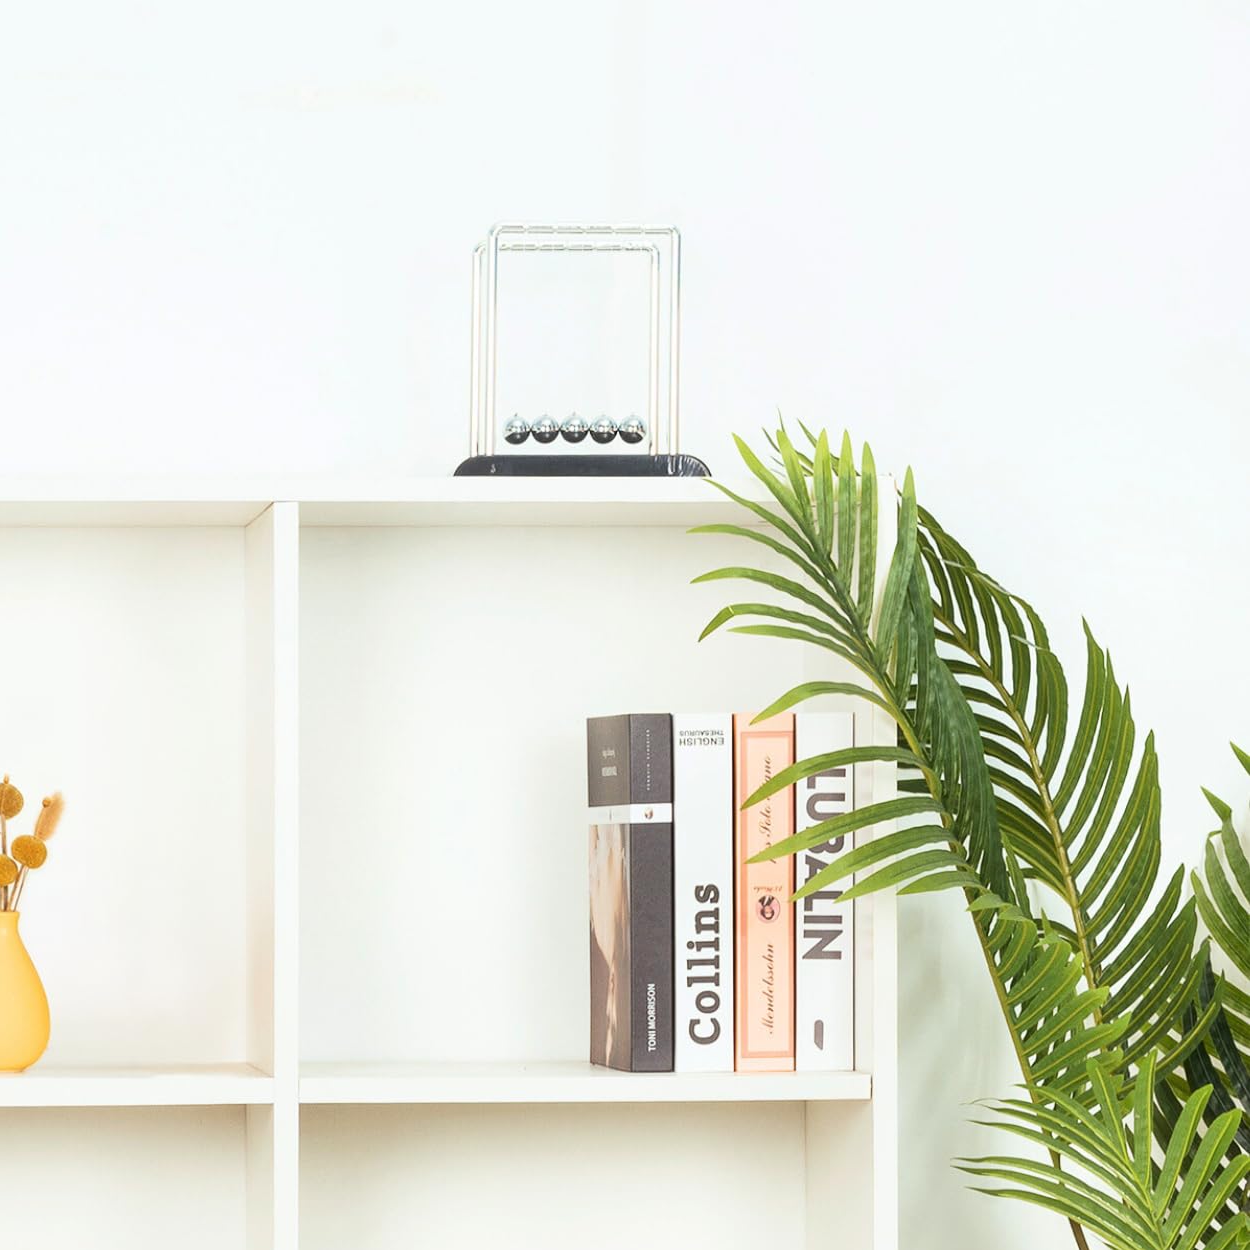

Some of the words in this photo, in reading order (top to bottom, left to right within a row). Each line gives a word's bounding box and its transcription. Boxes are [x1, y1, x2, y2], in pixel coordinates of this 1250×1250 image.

[679, 737, 725, 746] ENGLISH
[687, 883, 721, 1045] Collins
[647, 983, 656, 1030] MORRISON
[760, 943, 775, 1035] Mendelssohn
[647, 1031, 656, 1052] TONI
